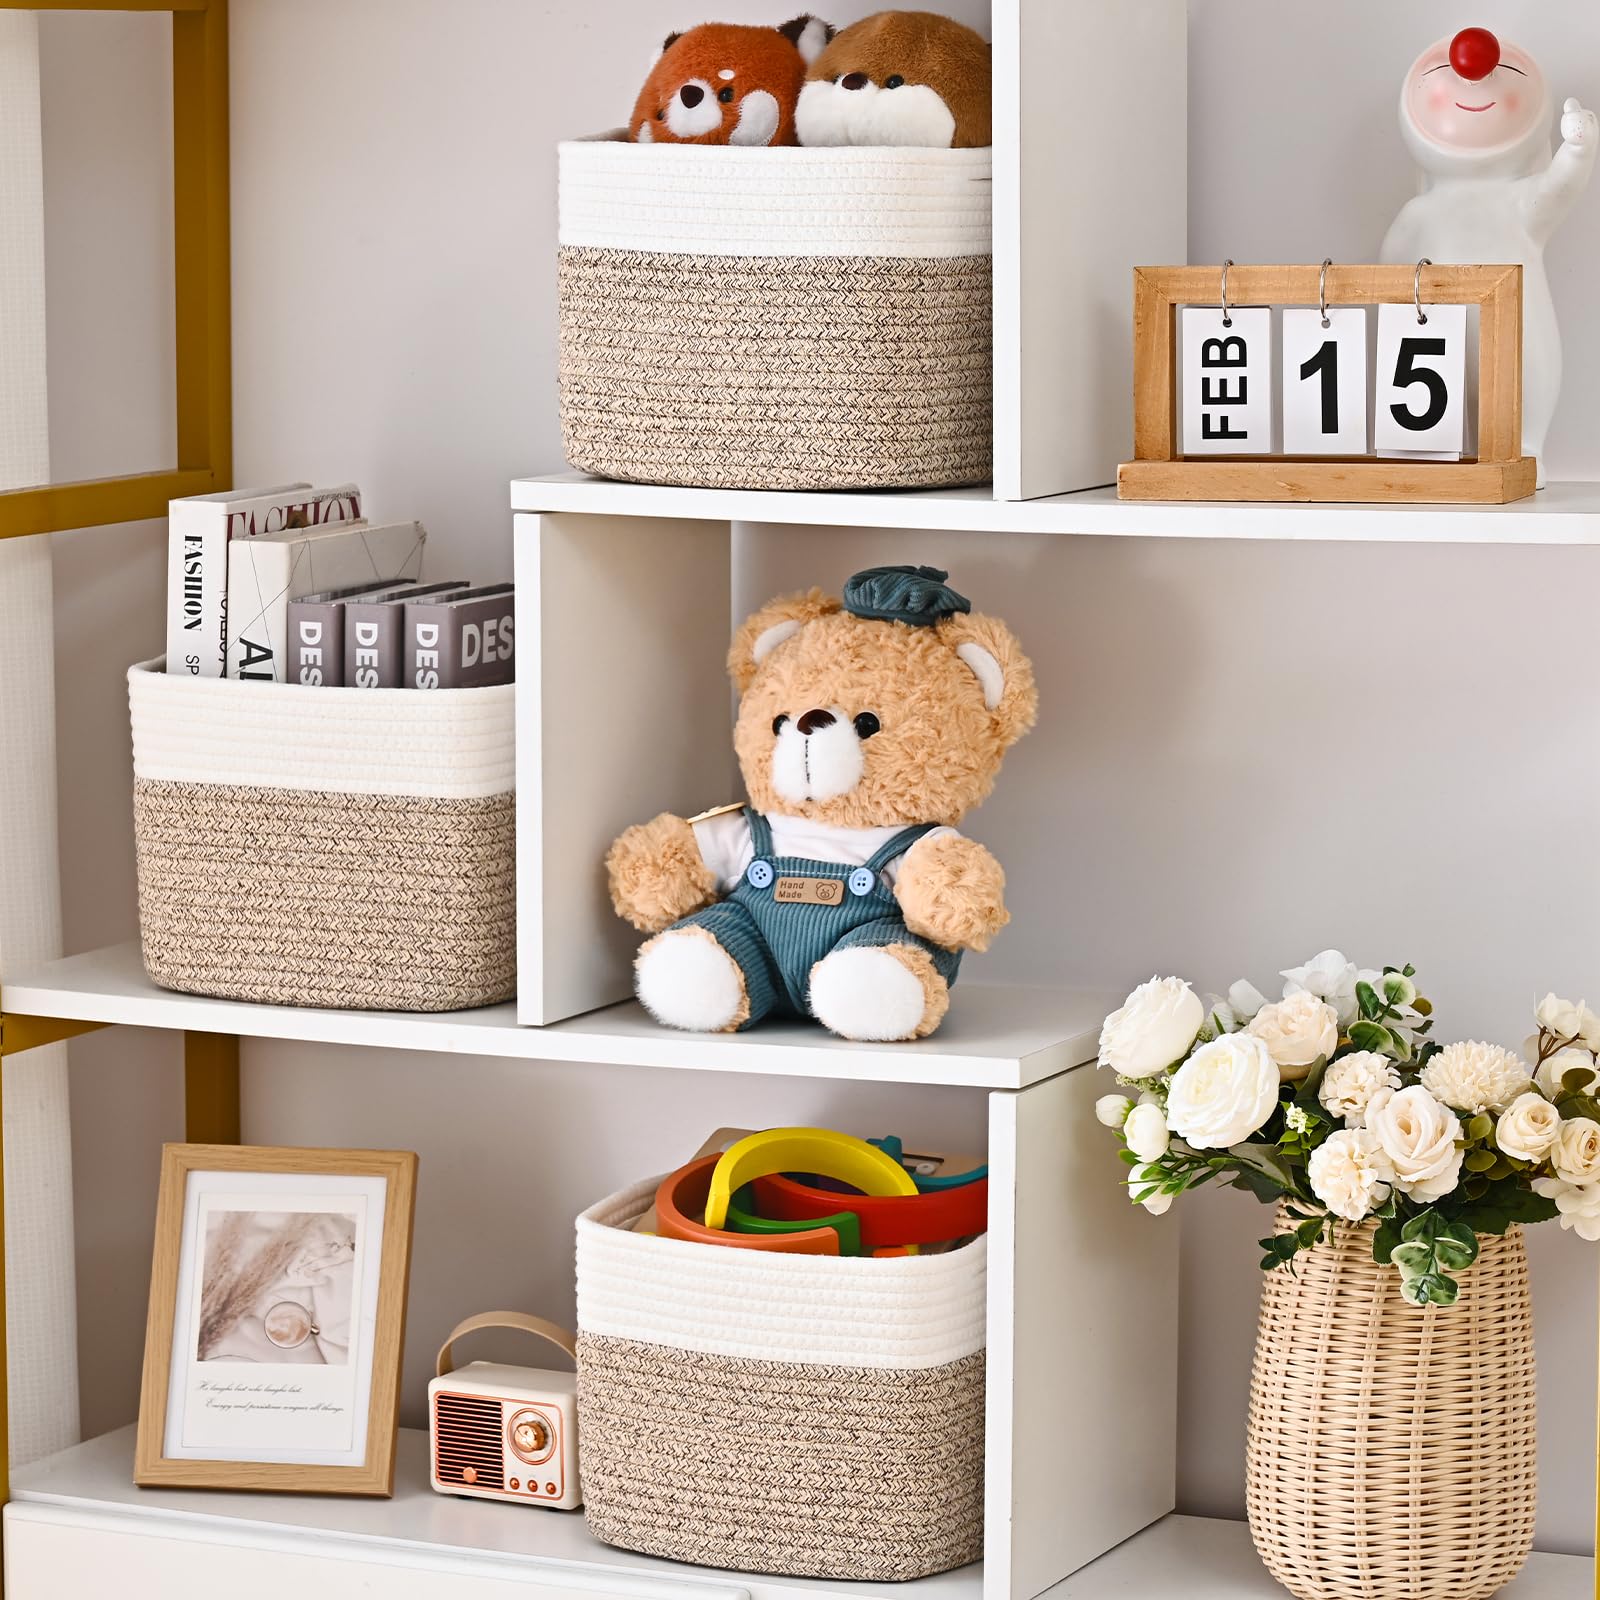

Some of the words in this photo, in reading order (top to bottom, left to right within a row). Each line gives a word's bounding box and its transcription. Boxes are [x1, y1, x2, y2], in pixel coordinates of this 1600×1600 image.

[1201, 334, 1248, 440] FEB
[1300, 340, 1339, 435] 1
[1389, 337, 1449, 432] 5
[183, 534, 203, 632] FASHION
[299, 620, 323, 687] DES
[355, 621, 379, 689] DES
[415, 623, 440, 689] DES
[461, 615, 514, 669] DES
[778, 890, 803, 899] Made
[780, 881, 805, 890] Hand
